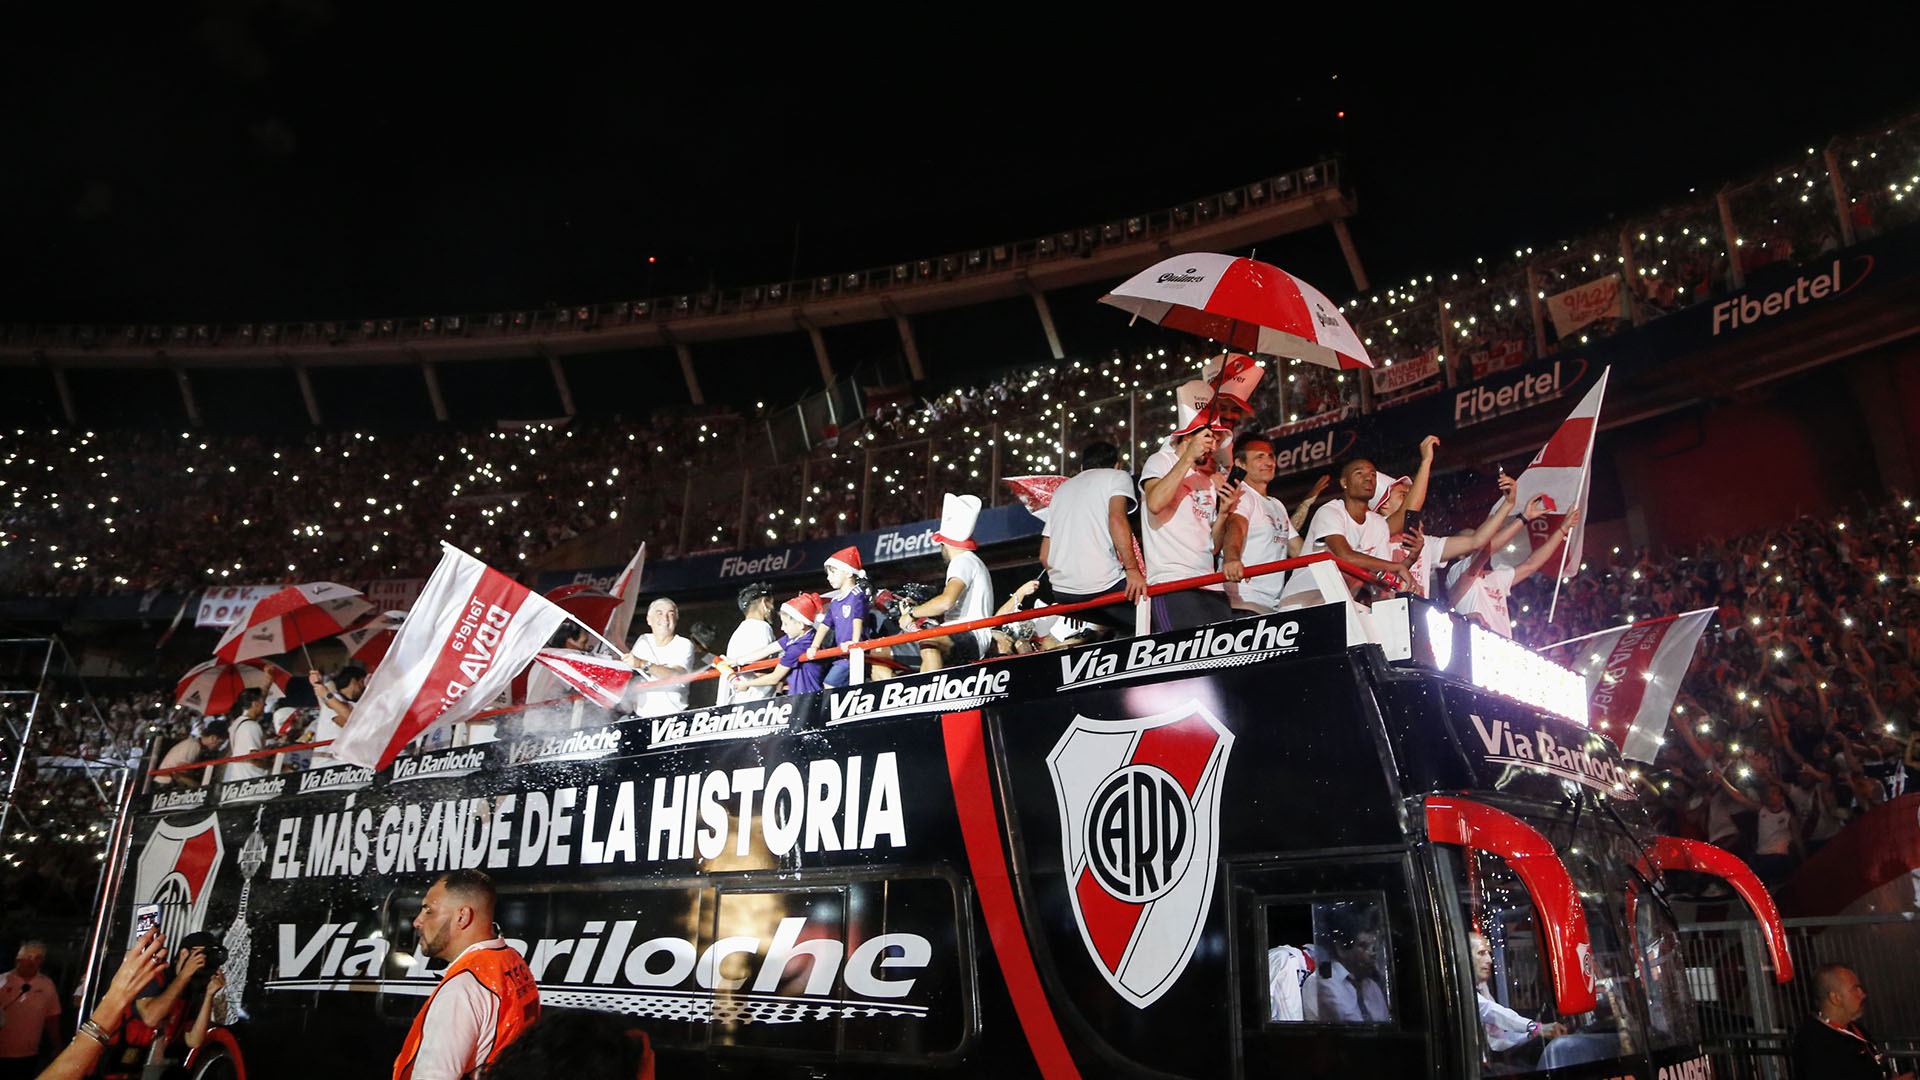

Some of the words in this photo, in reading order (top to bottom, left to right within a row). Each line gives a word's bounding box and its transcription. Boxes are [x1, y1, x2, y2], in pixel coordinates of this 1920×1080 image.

[1156, 272, 1205, 284] Quilmes
[1713, 259, 1840, 336] Fibertel
[1455, 361, 1560, 421] Fibertel
[720, 549, 790, 578] Fibertel
[1126, 619, 1299, 670] Bariloche
[878, 667, 1011, 710] Bariloche
[689, 701, 793, 735] Bariloche
[418, 748, 485, 774] Bariloche
[541, 726, 622, 757] Bariloche
[1536, 730, 1636, 793] Bariloche
[270, 817, 302, 879] EL
[305, 792, 373, 877] MÁS
[376, 794, 517, 874] GR4NDE
[518, 787, 578, 867] DE
[580, 781, 637, 864] LA
[647, 752, 907, 861] HISTORIA
